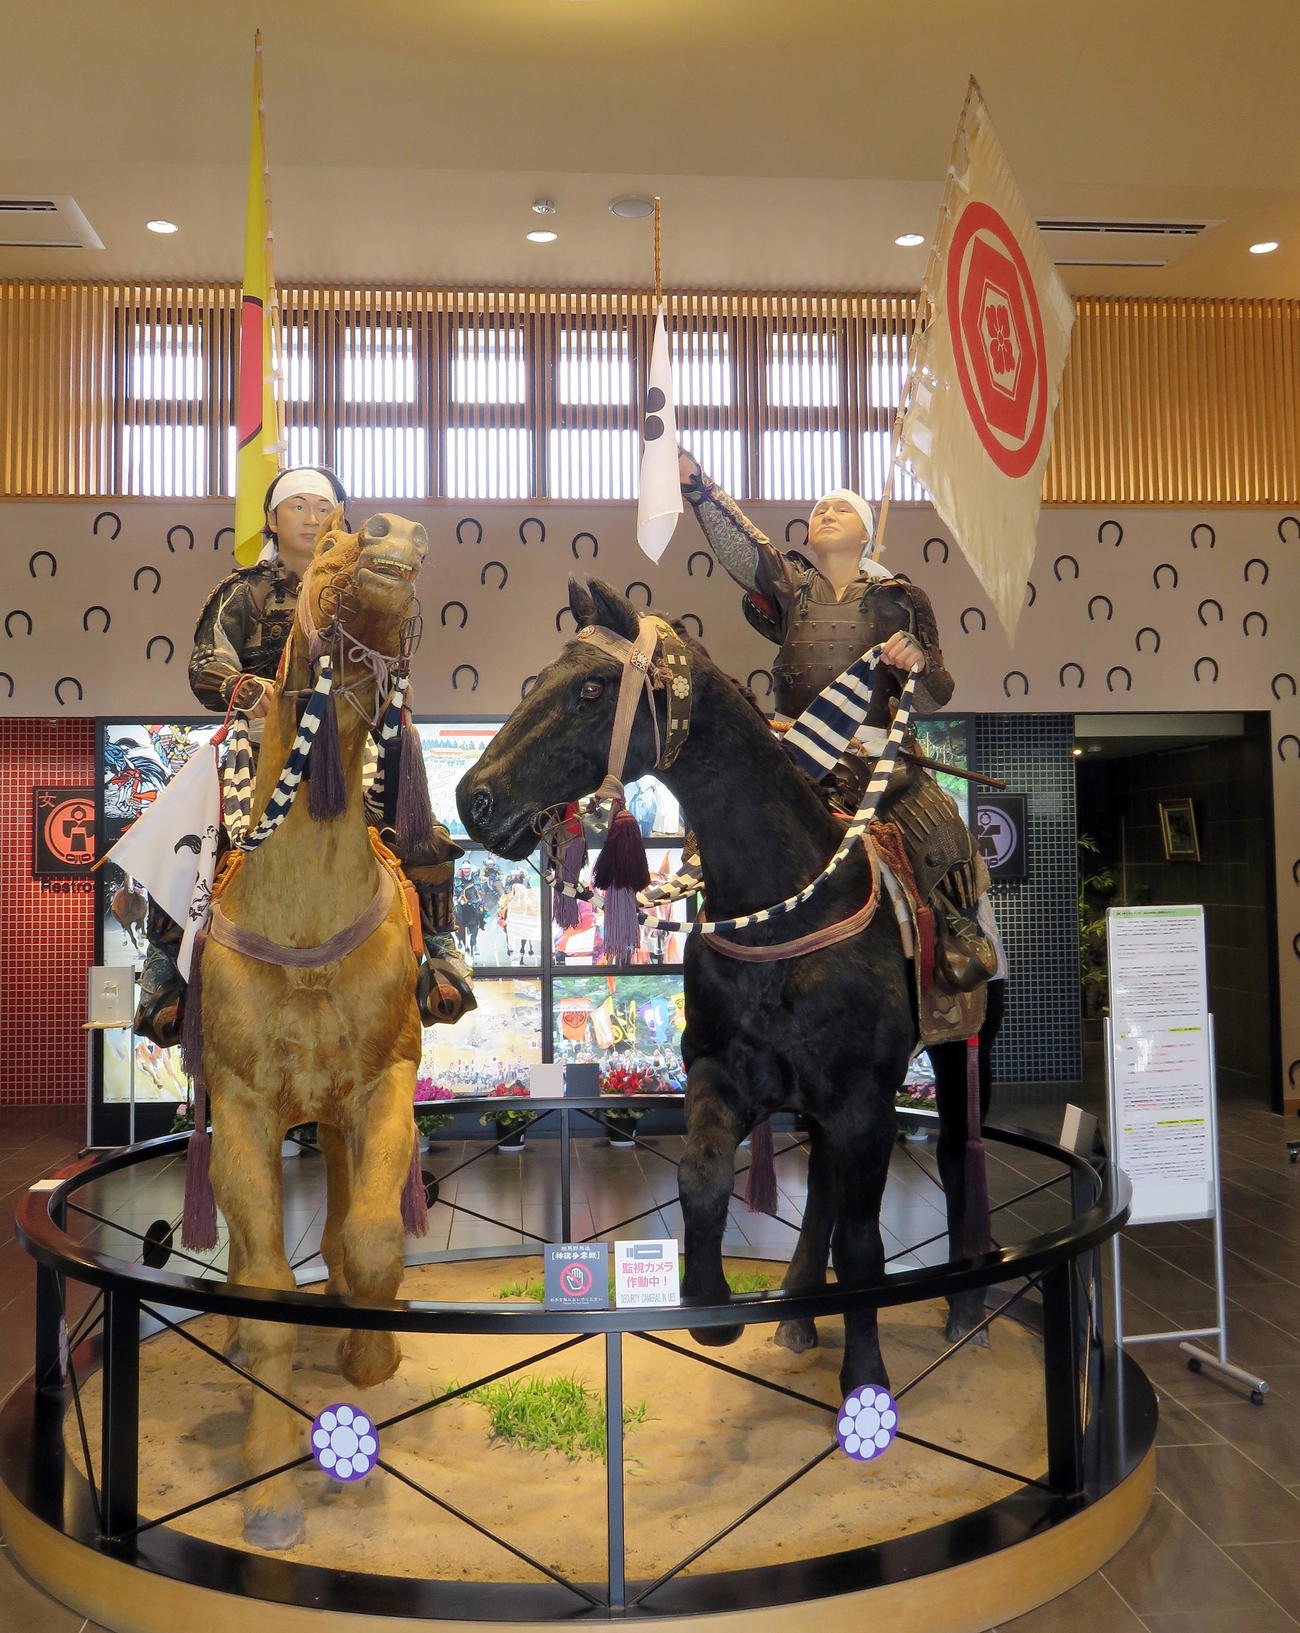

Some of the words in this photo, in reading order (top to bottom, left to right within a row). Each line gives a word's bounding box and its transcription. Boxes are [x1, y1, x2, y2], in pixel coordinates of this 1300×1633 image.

[38, 791, 57, 809] 女
[41, 880, 96, 894] Restro
[622, 1261, 674, 1274] 監視カメラ
[620, 1293, 640, 1304] SECURITY
